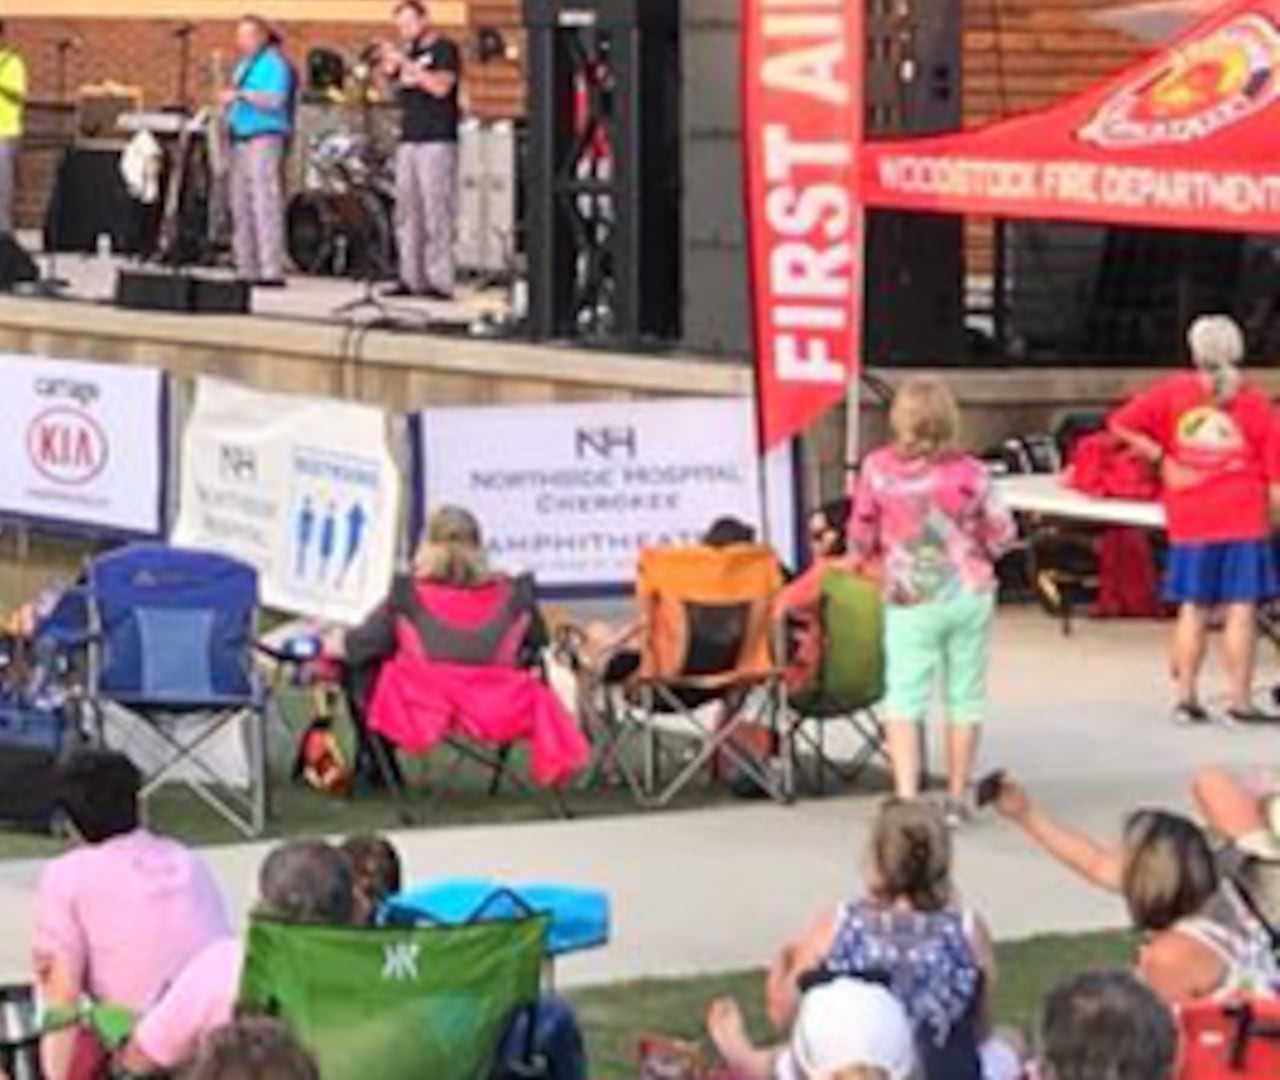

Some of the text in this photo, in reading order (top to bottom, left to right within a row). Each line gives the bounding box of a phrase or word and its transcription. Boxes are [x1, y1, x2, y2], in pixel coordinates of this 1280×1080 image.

[877, 156, 1037, 197] WOODSTOCK
[1042, 162, 1098, 202] FIRE
[764, 128, 848, 385] FIRST
[40, 423, 95, 468] KIA
[574, 426, 637, 459] NH
[470, 464, 741, 491] NORTHSIDE HOSPITAL
[535, 493, 680, 514] CHEROKEE
[484, 531, 705, 553] AMPHITHEAT
